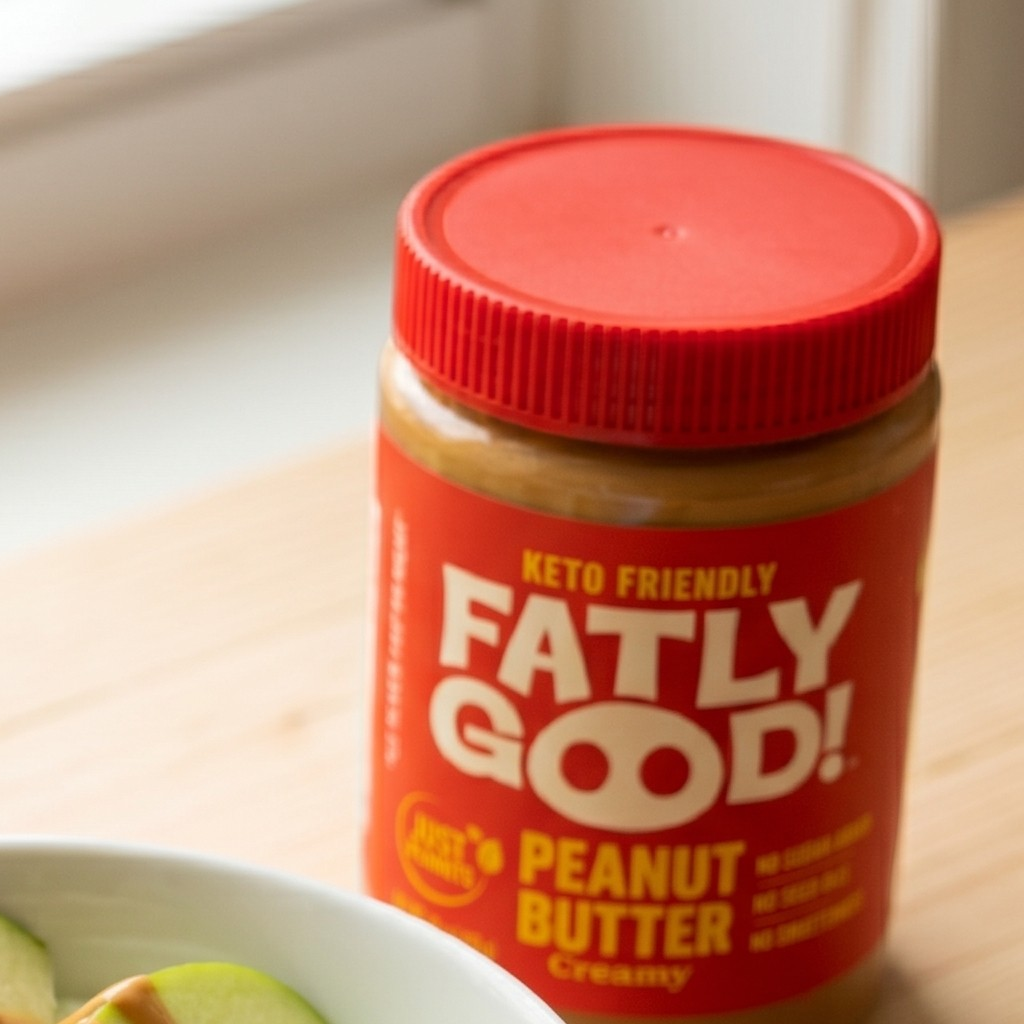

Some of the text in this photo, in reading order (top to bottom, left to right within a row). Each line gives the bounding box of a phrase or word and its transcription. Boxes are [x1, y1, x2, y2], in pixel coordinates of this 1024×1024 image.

[522, 549, 777, 600] KETO FRIENDLY
[440, 562, 863, 709] FATLY
[429, 676, 853, 833] GOOD!
[519, 831, 746, 902] PEANUT
[517, 888, 733, 960] BUTTER
[548, 952, 693, 993] Creamy
